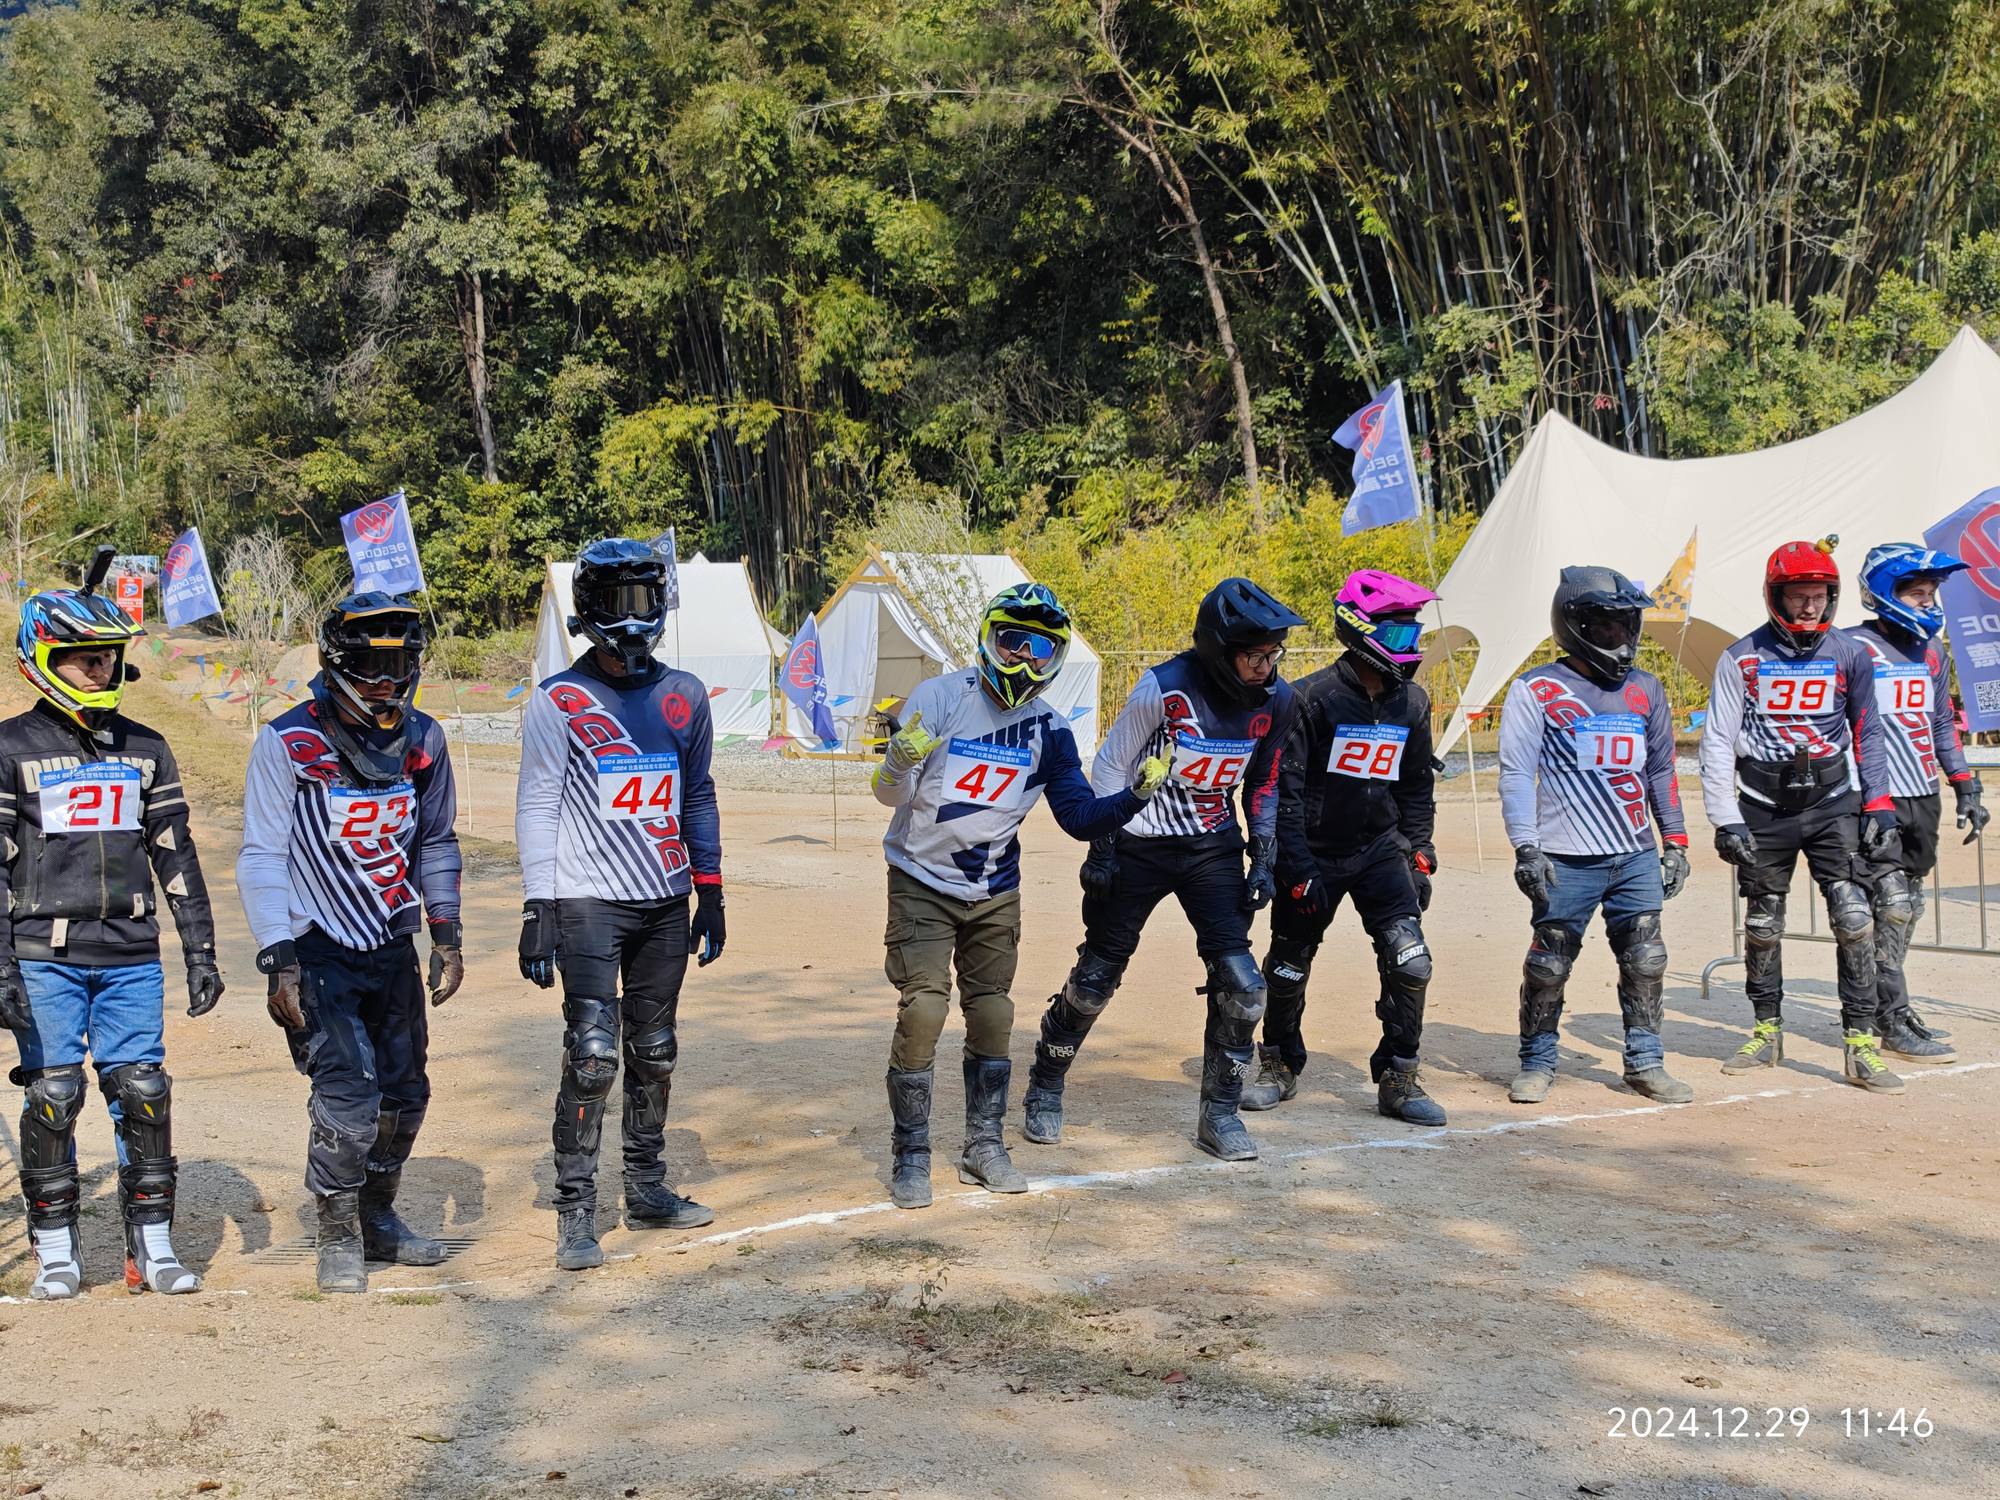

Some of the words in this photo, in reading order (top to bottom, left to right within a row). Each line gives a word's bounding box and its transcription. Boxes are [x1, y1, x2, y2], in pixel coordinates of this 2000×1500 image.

[1767, 679, 1827, 710] 39
[1893, 679, 1926, 708] 18
[1336, 741, 1398, 775] 28
[1595, 735, 1634, 766] 10
[955, 763, 1019, 802] 47
[1180, 757, 1244, 786] 46
[68, 785, 124, 826] 21
[612, 774, 673, 814] 44
[340, 795, 410, 837] 23
[1397, 945, 1425, 965] LEATT
[1273, 965, 1304, 982] LEATT
